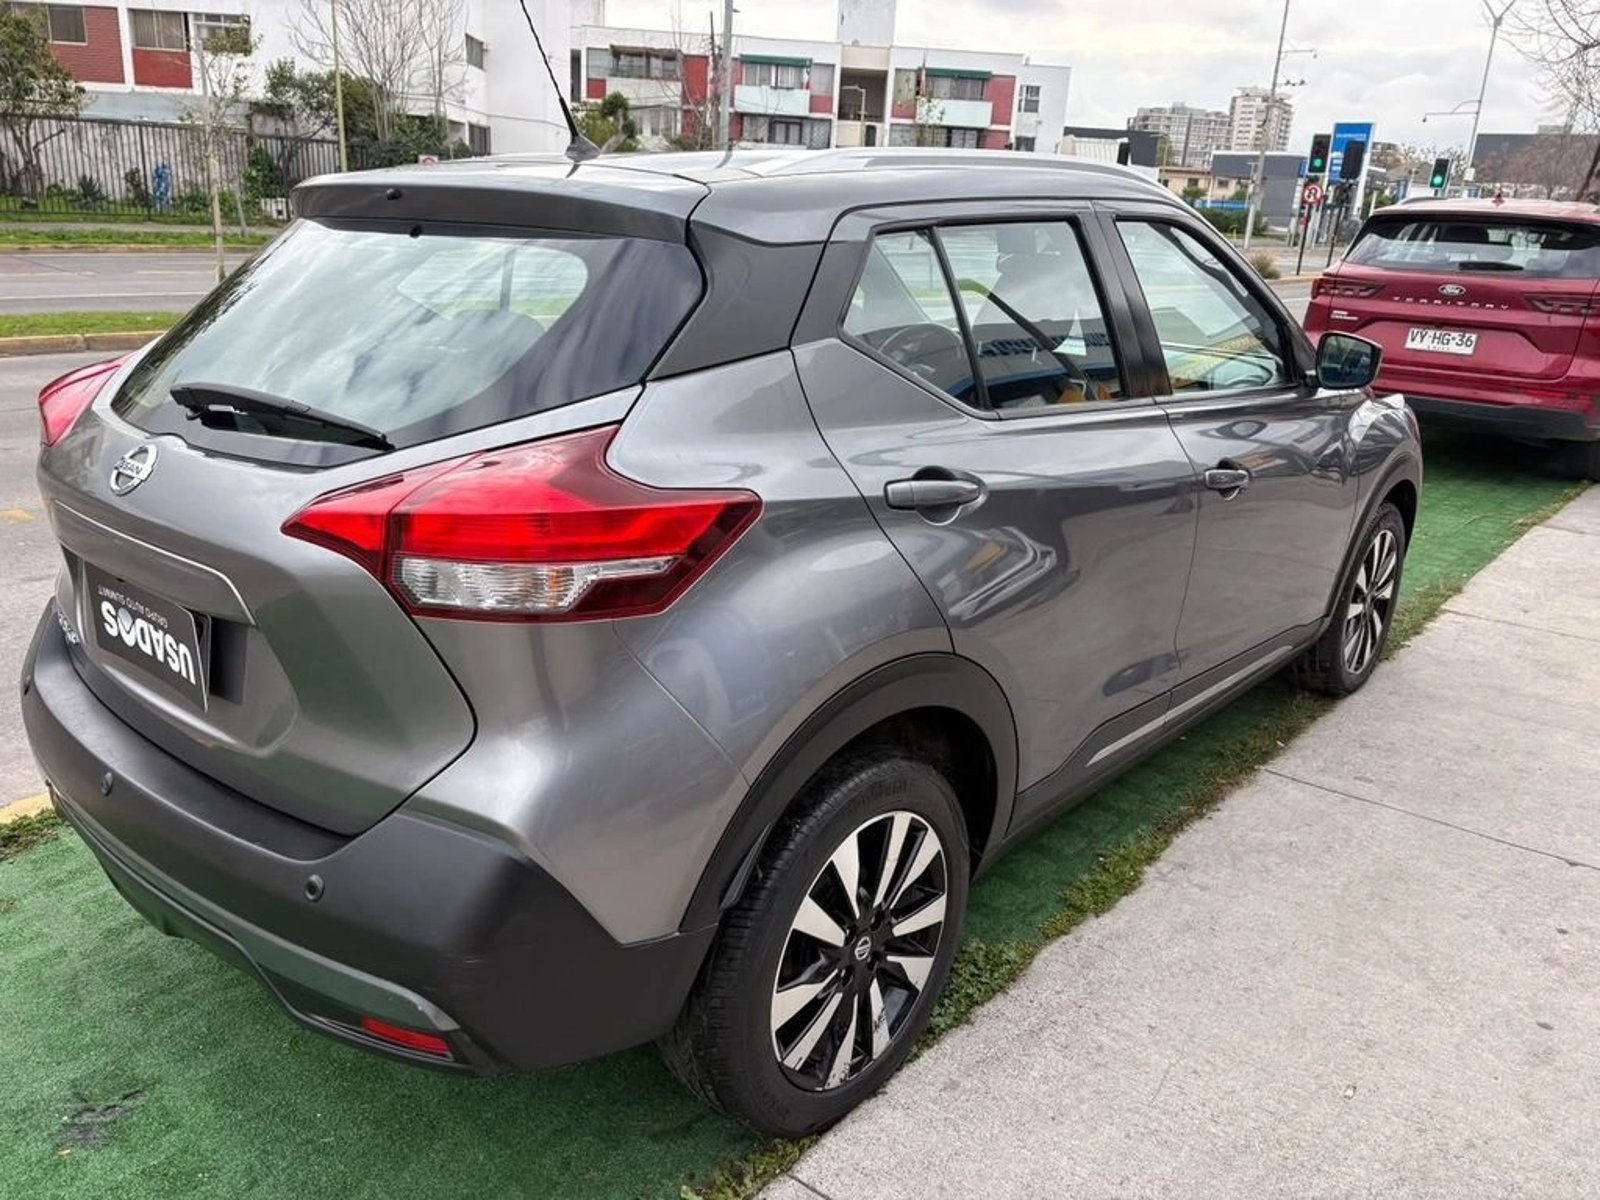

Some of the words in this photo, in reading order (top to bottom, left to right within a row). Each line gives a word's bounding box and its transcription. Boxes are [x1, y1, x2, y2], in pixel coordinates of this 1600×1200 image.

[1393, 296, 1509, 309] TERRITORY
[126, 597, 145, 615] AUTO
[101, 601, 196, 685] USADOS
